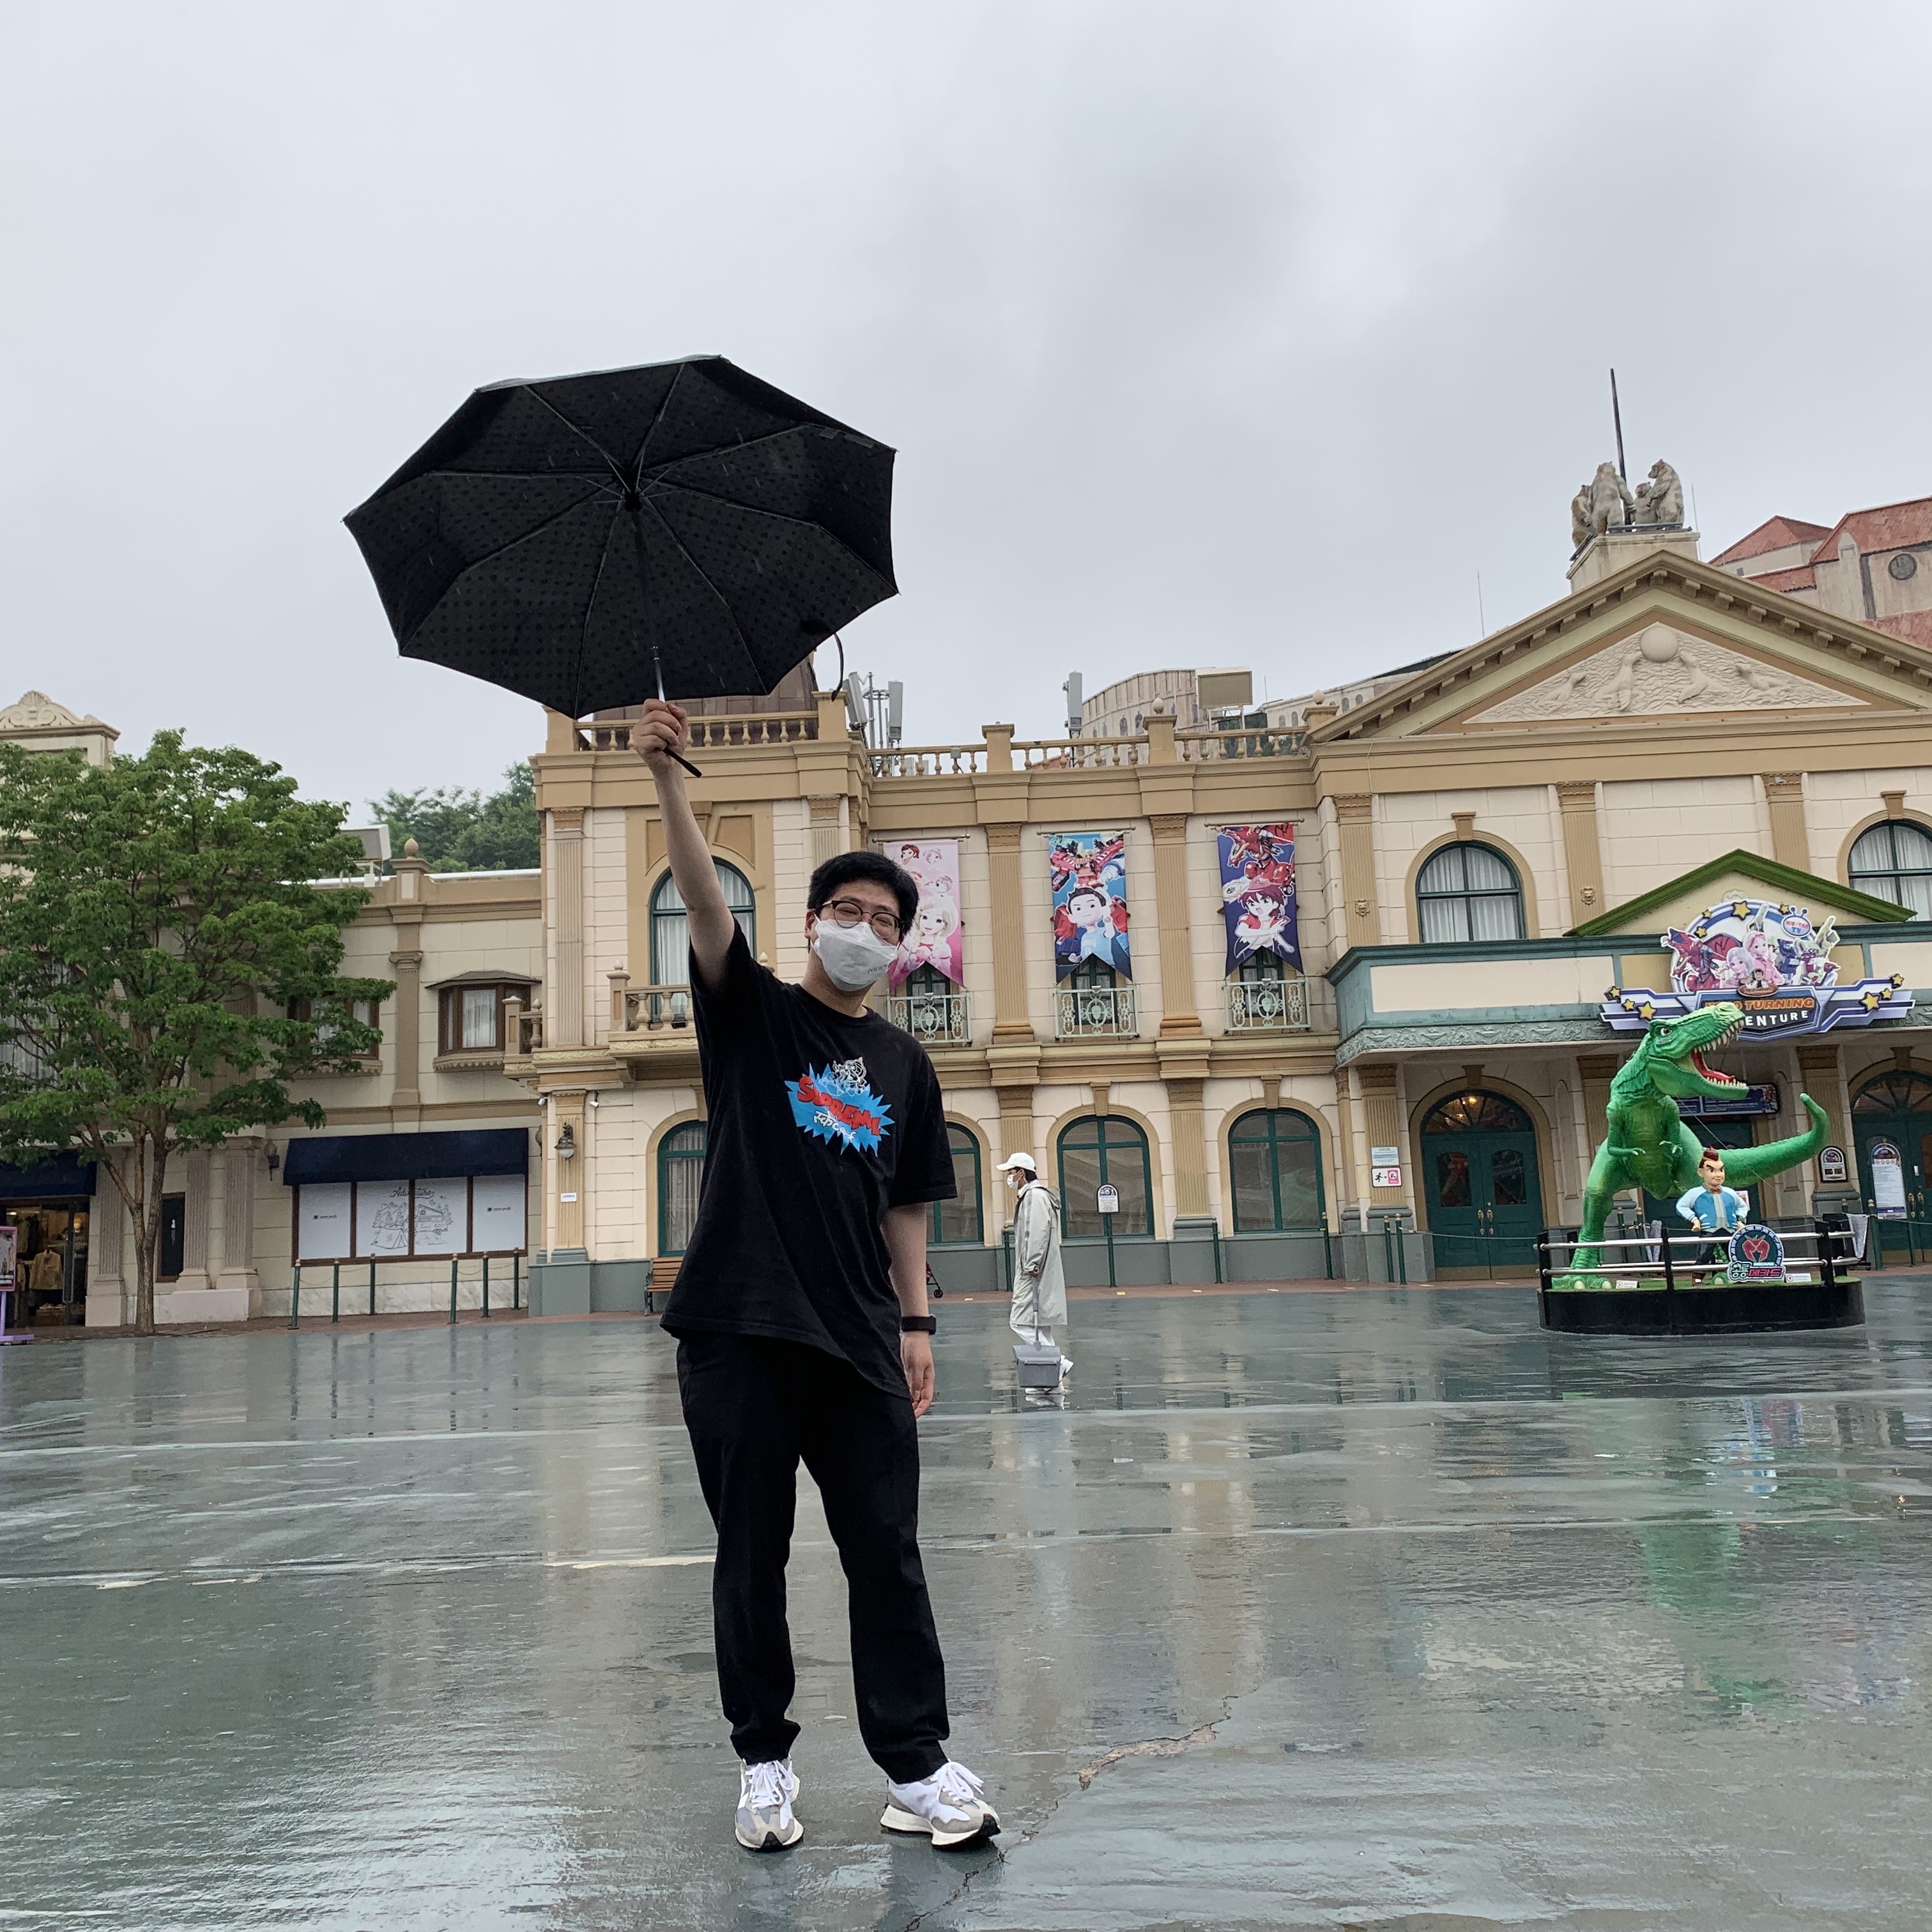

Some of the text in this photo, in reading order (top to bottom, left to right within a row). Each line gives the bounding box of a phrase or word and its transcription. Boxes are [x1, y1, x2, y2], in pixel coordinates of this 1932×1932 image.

[1745, 997, 1815, 1011] TURNING
[1745, 1010, 1809, 1027] ENTURE
[1749, 1268, 1782, 1276] 메카드
